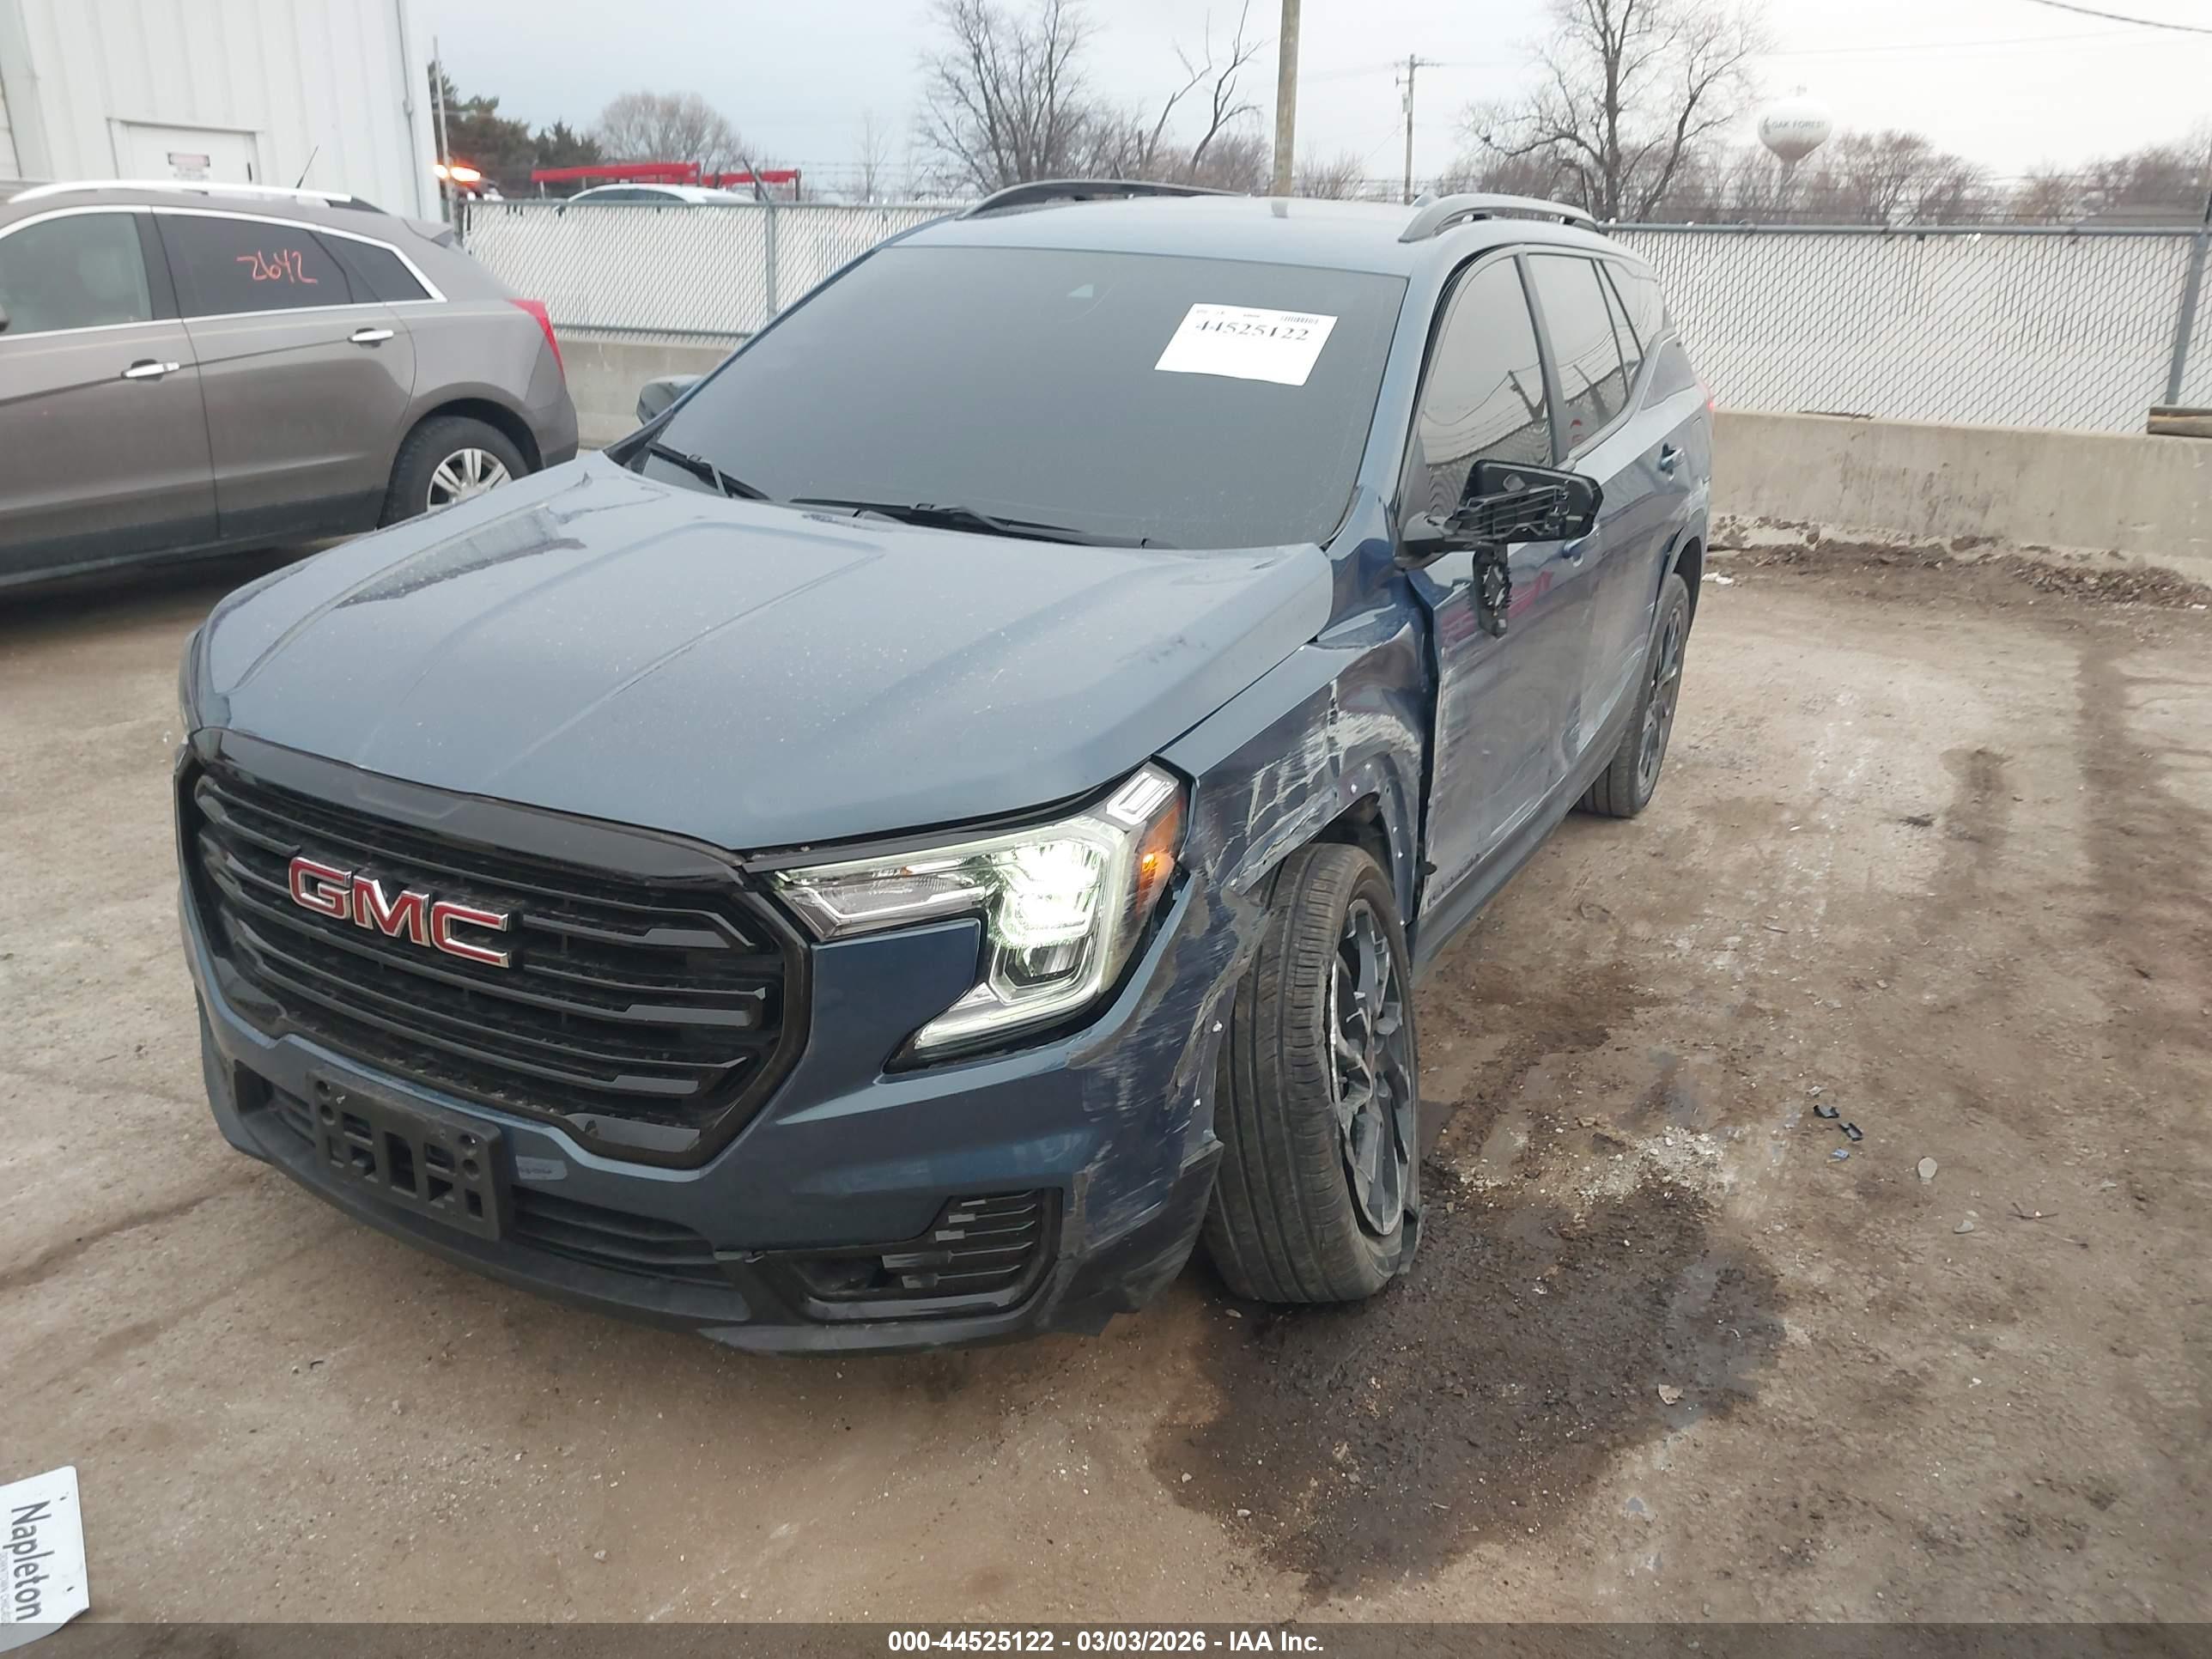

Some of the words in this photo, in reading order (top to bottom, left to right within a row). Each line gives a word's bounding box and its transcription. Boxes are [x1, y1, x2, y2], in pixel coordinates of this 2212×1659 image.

[236, 249, 318, 283] 2642
[1195, 320, 1310, 342] 44525122
[289, 856, 509, 969] GMC
[3, 1499, 55, 1621] Napleton
